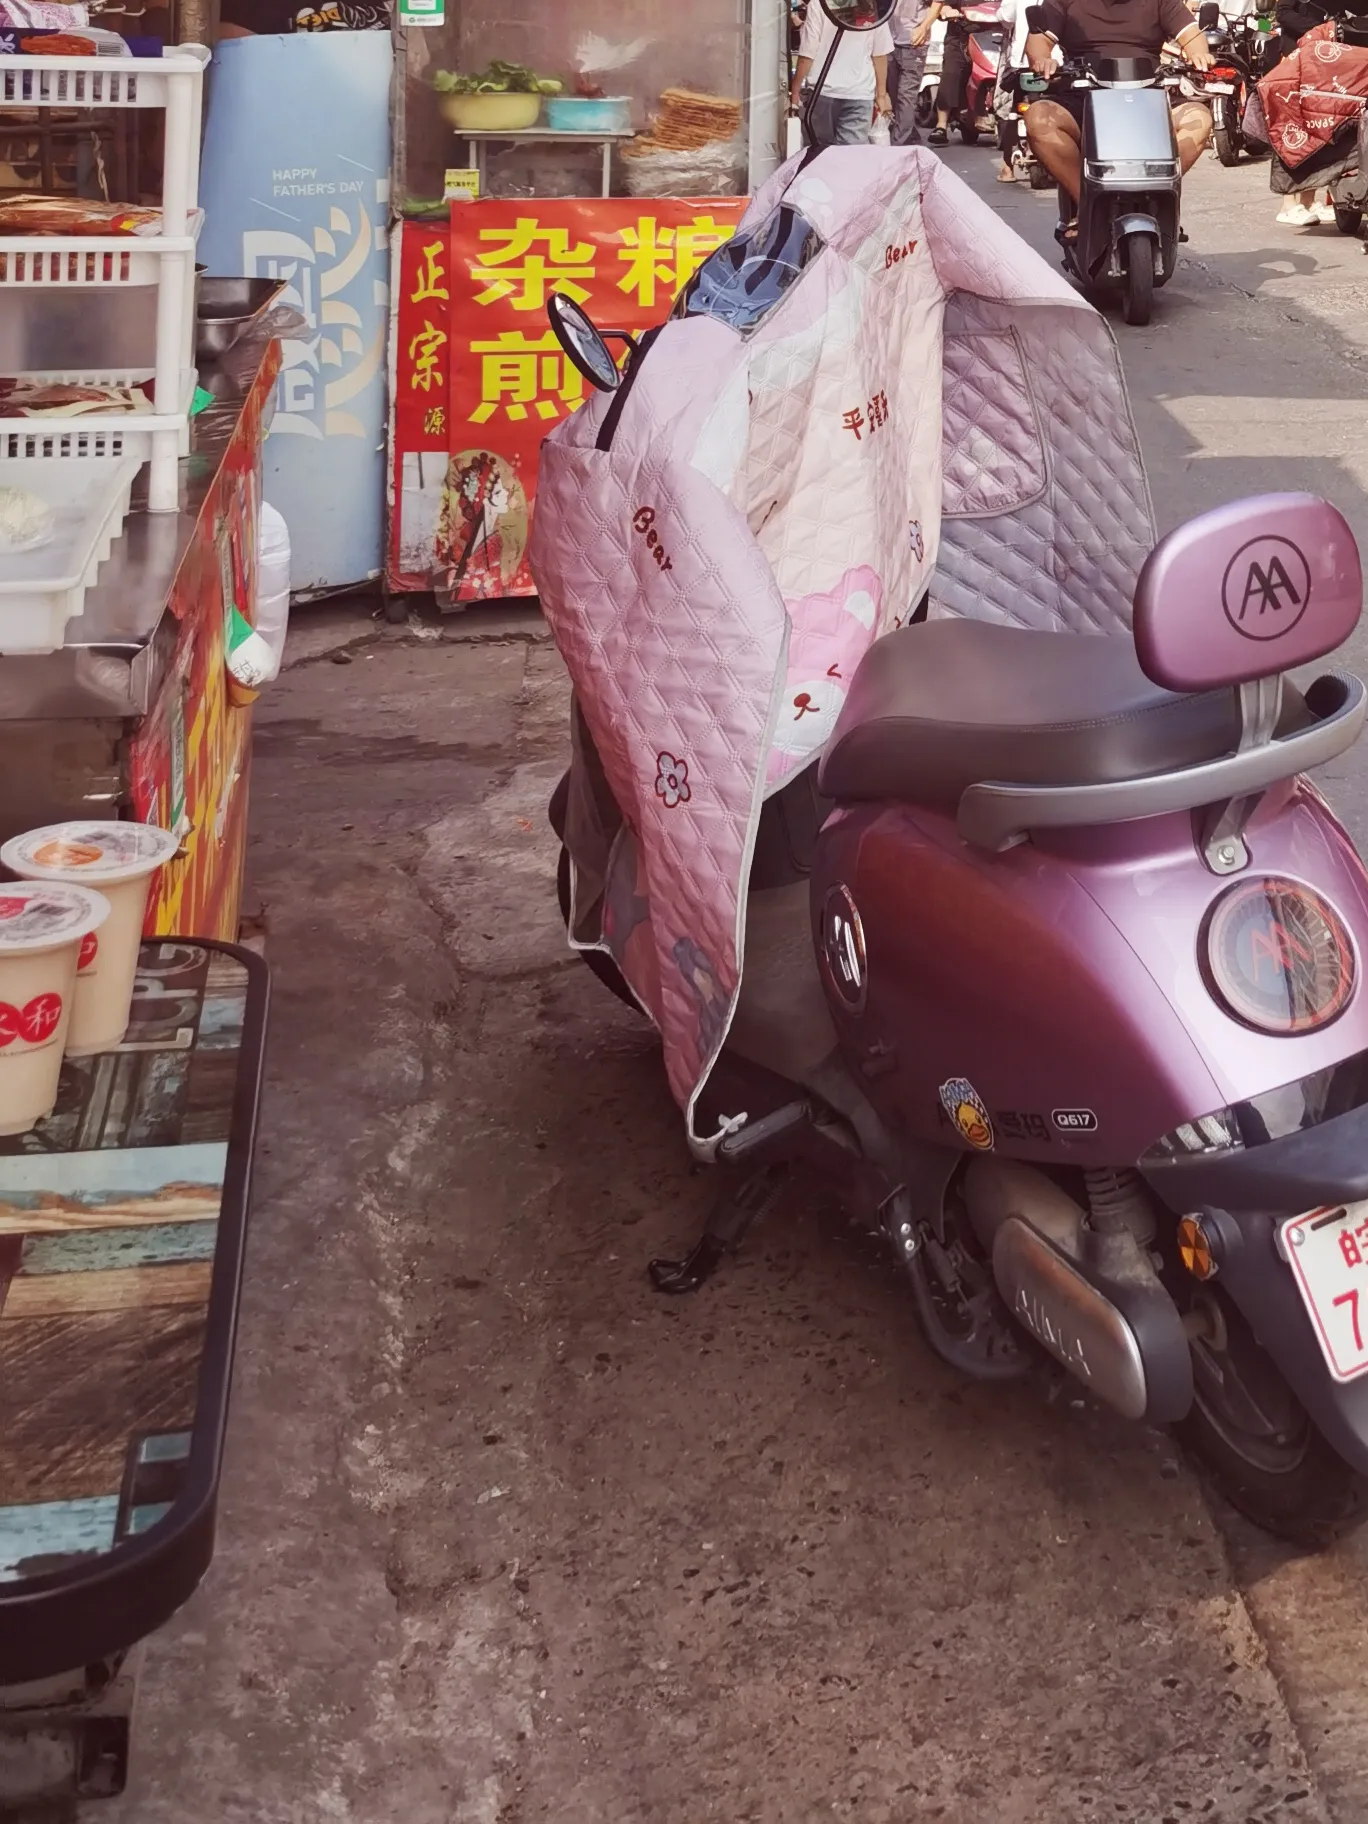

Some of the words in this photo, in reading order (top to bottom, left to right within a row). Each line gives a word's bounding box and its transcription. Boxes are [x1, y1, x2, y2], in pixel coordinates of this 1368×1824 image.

[272, 168, 317, 180] HAPPY
[273, 182, 336, 197] FATHER'S
[339, 180, 364, 194] DAY
[469, 216, 738, 311] 杂粮
[885, 240, 918, 269] Bear
[408, 240, 450, 392] 正宗
[632, 506, 673, 572] Bear
[1057, 1114, 1091, 1127] Q617
